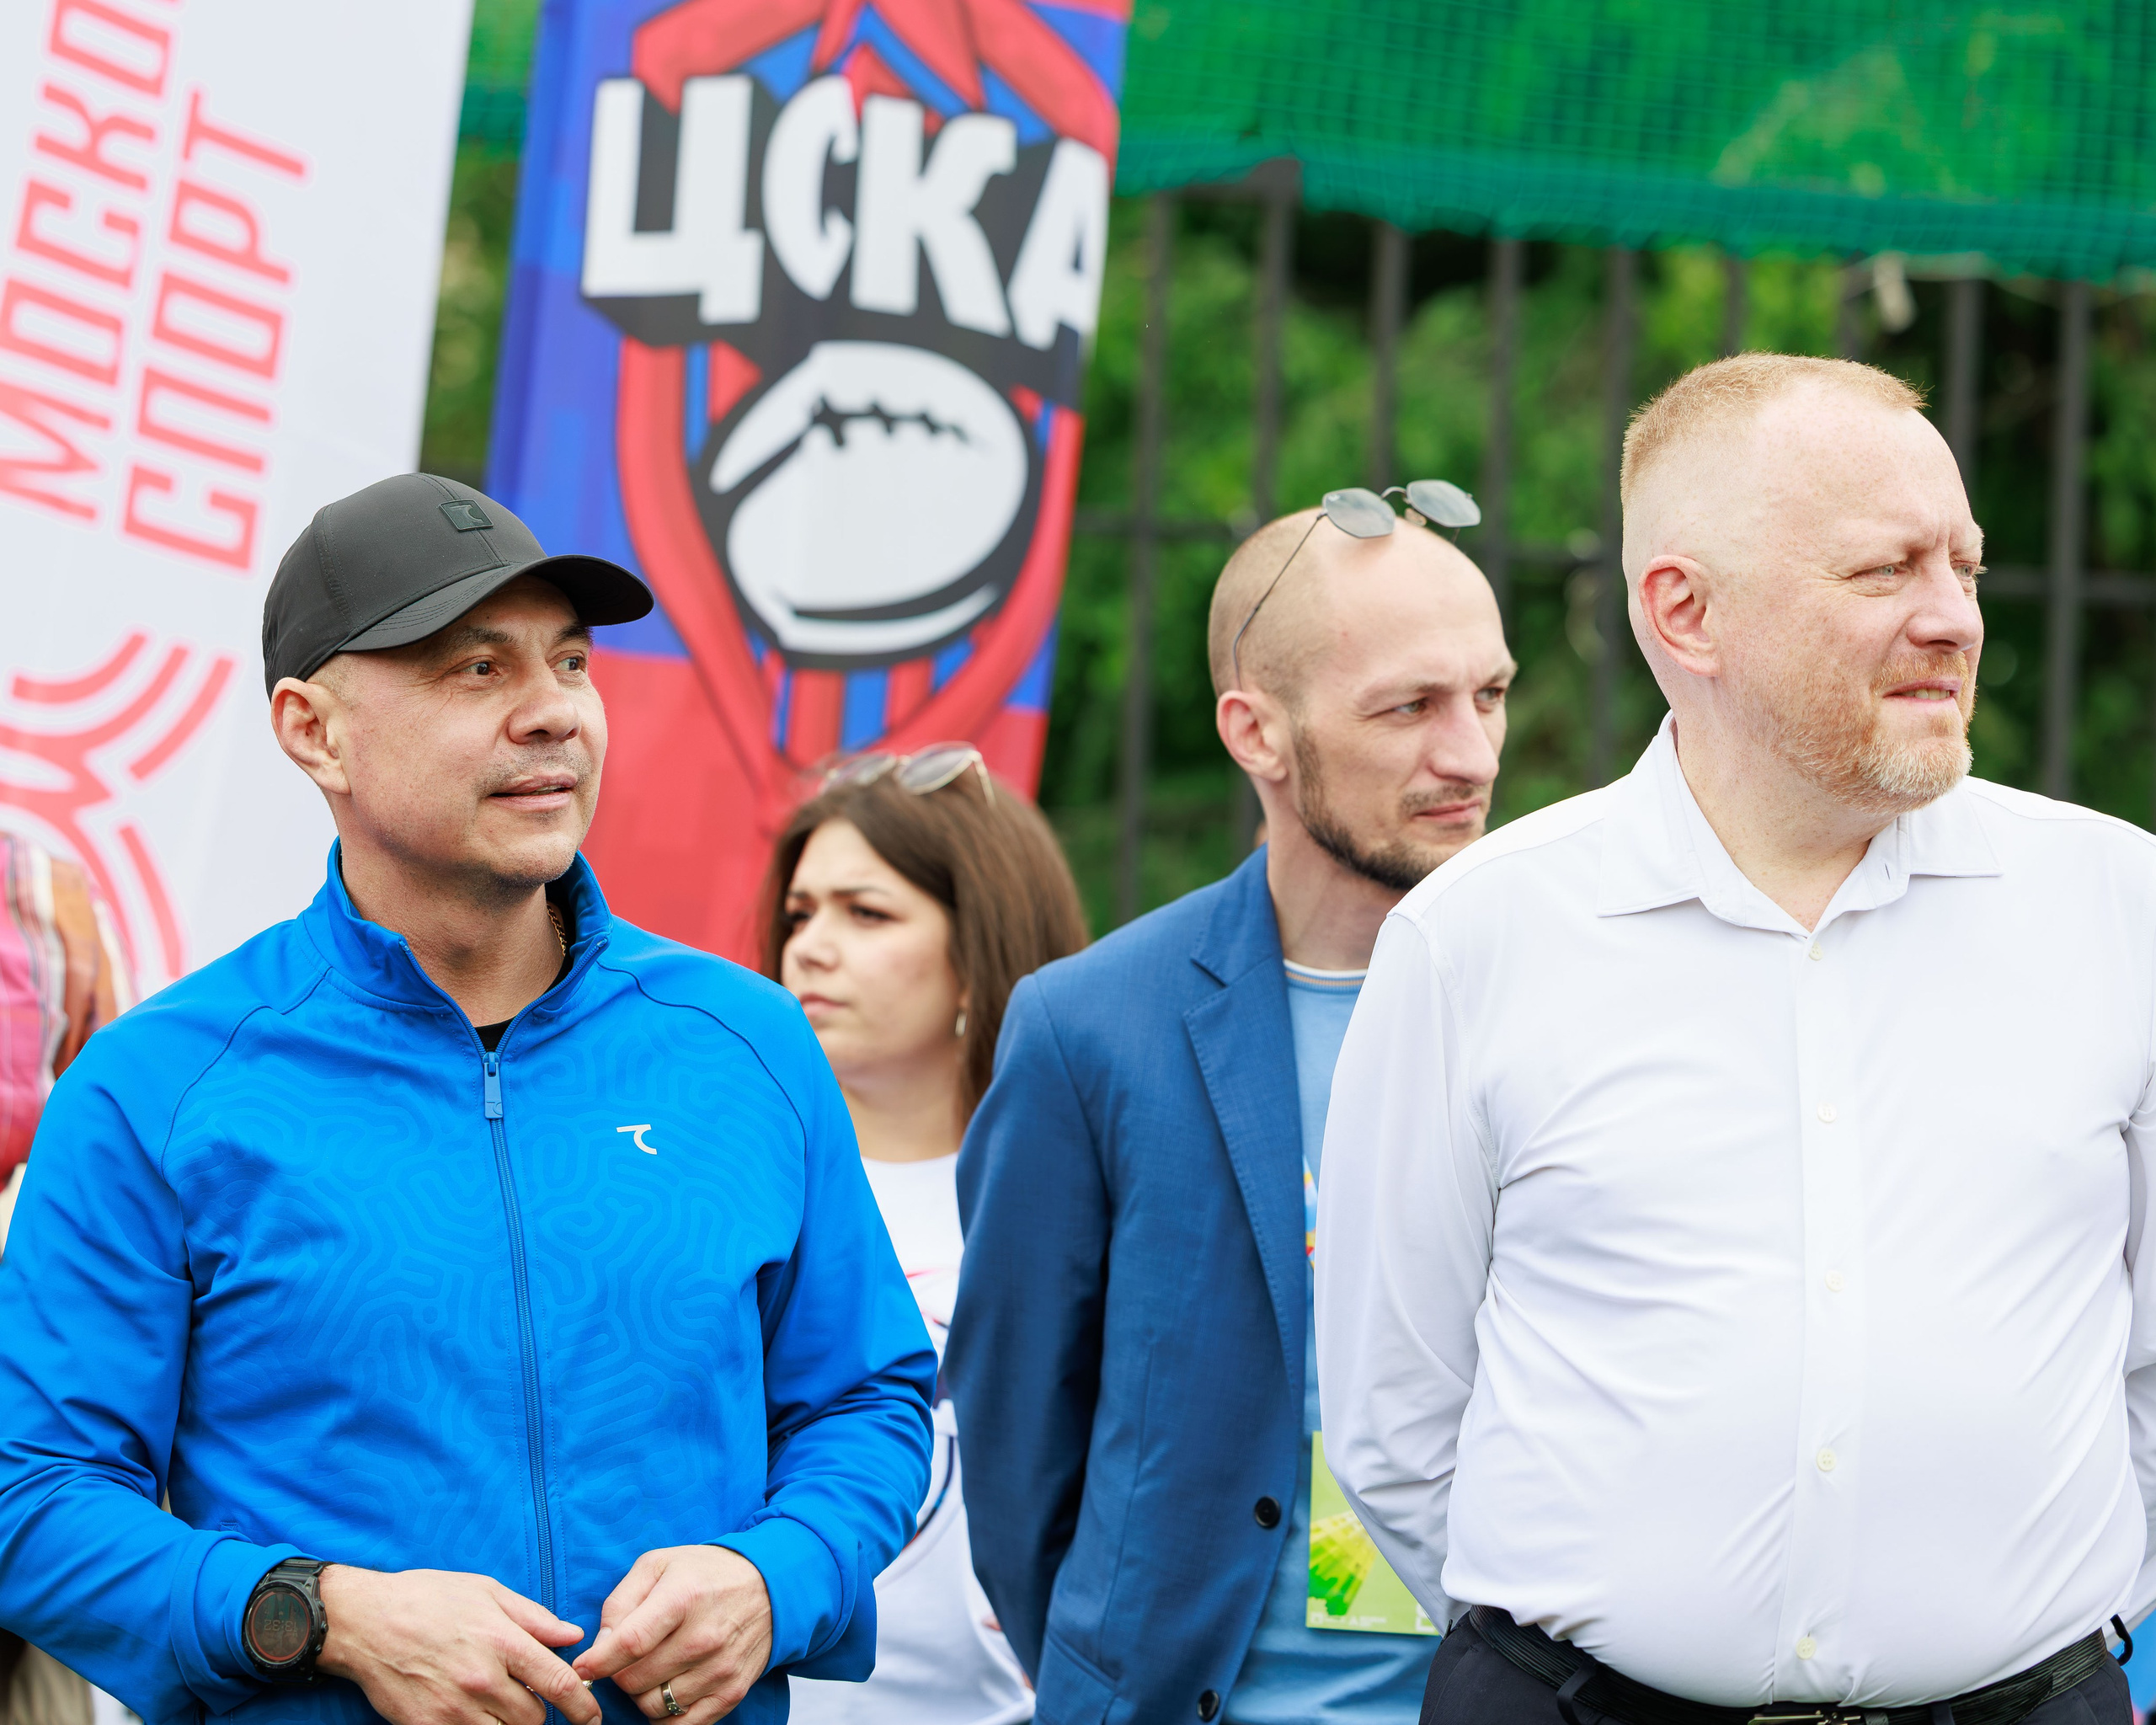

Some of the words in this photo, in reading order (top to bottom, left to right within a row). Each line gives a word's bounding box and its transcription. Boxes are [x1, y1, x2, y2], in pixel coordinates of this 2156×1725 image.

[0, 0, 179, 522] МОСКО
[123, 89, 306, 571] СПОРТ
[581, 73, 1110, 350] ЦСКА
[264, 1620, 297, 1632] 13:32
